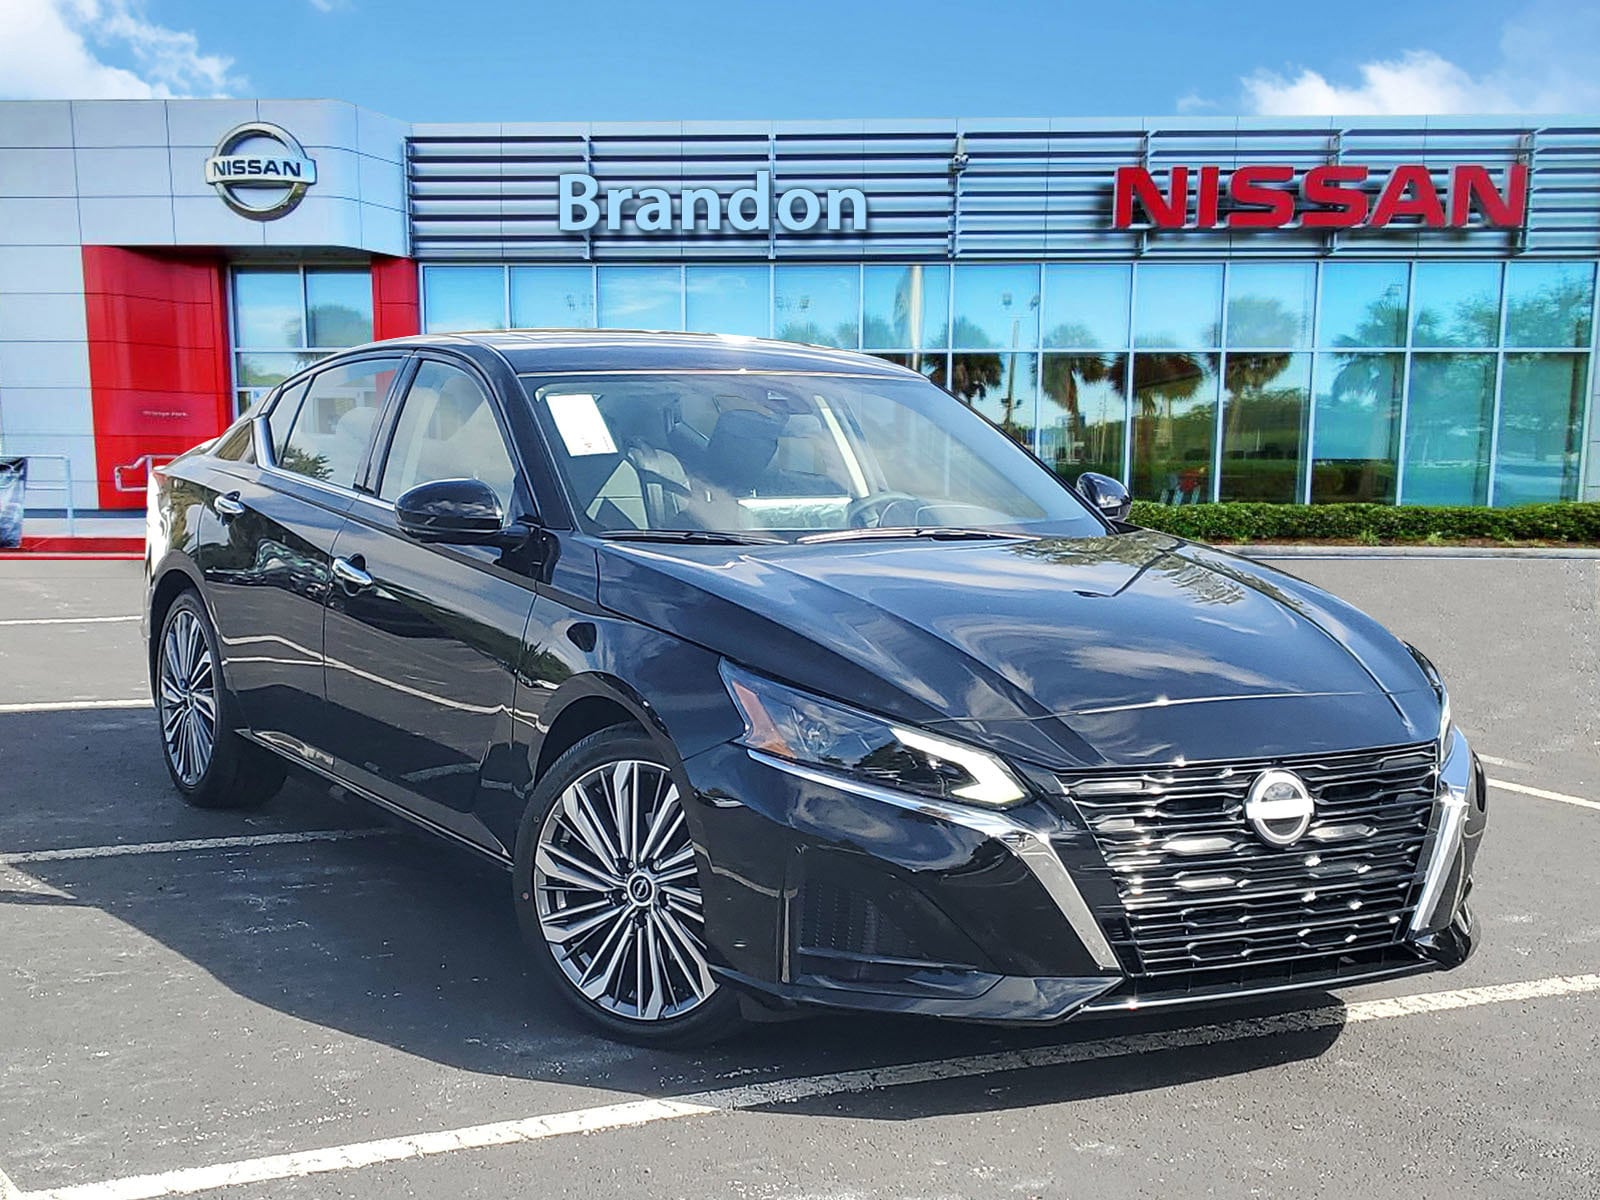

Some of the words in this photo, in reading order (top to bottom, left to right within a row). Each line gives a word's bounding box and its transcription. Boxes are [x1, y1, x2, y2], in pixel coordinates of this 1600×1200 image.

[213, 160, 301, 177] NISSAN
[1113, 165, 1528, 228] NISSAN
[559, 170, 867, 231] Brandon
